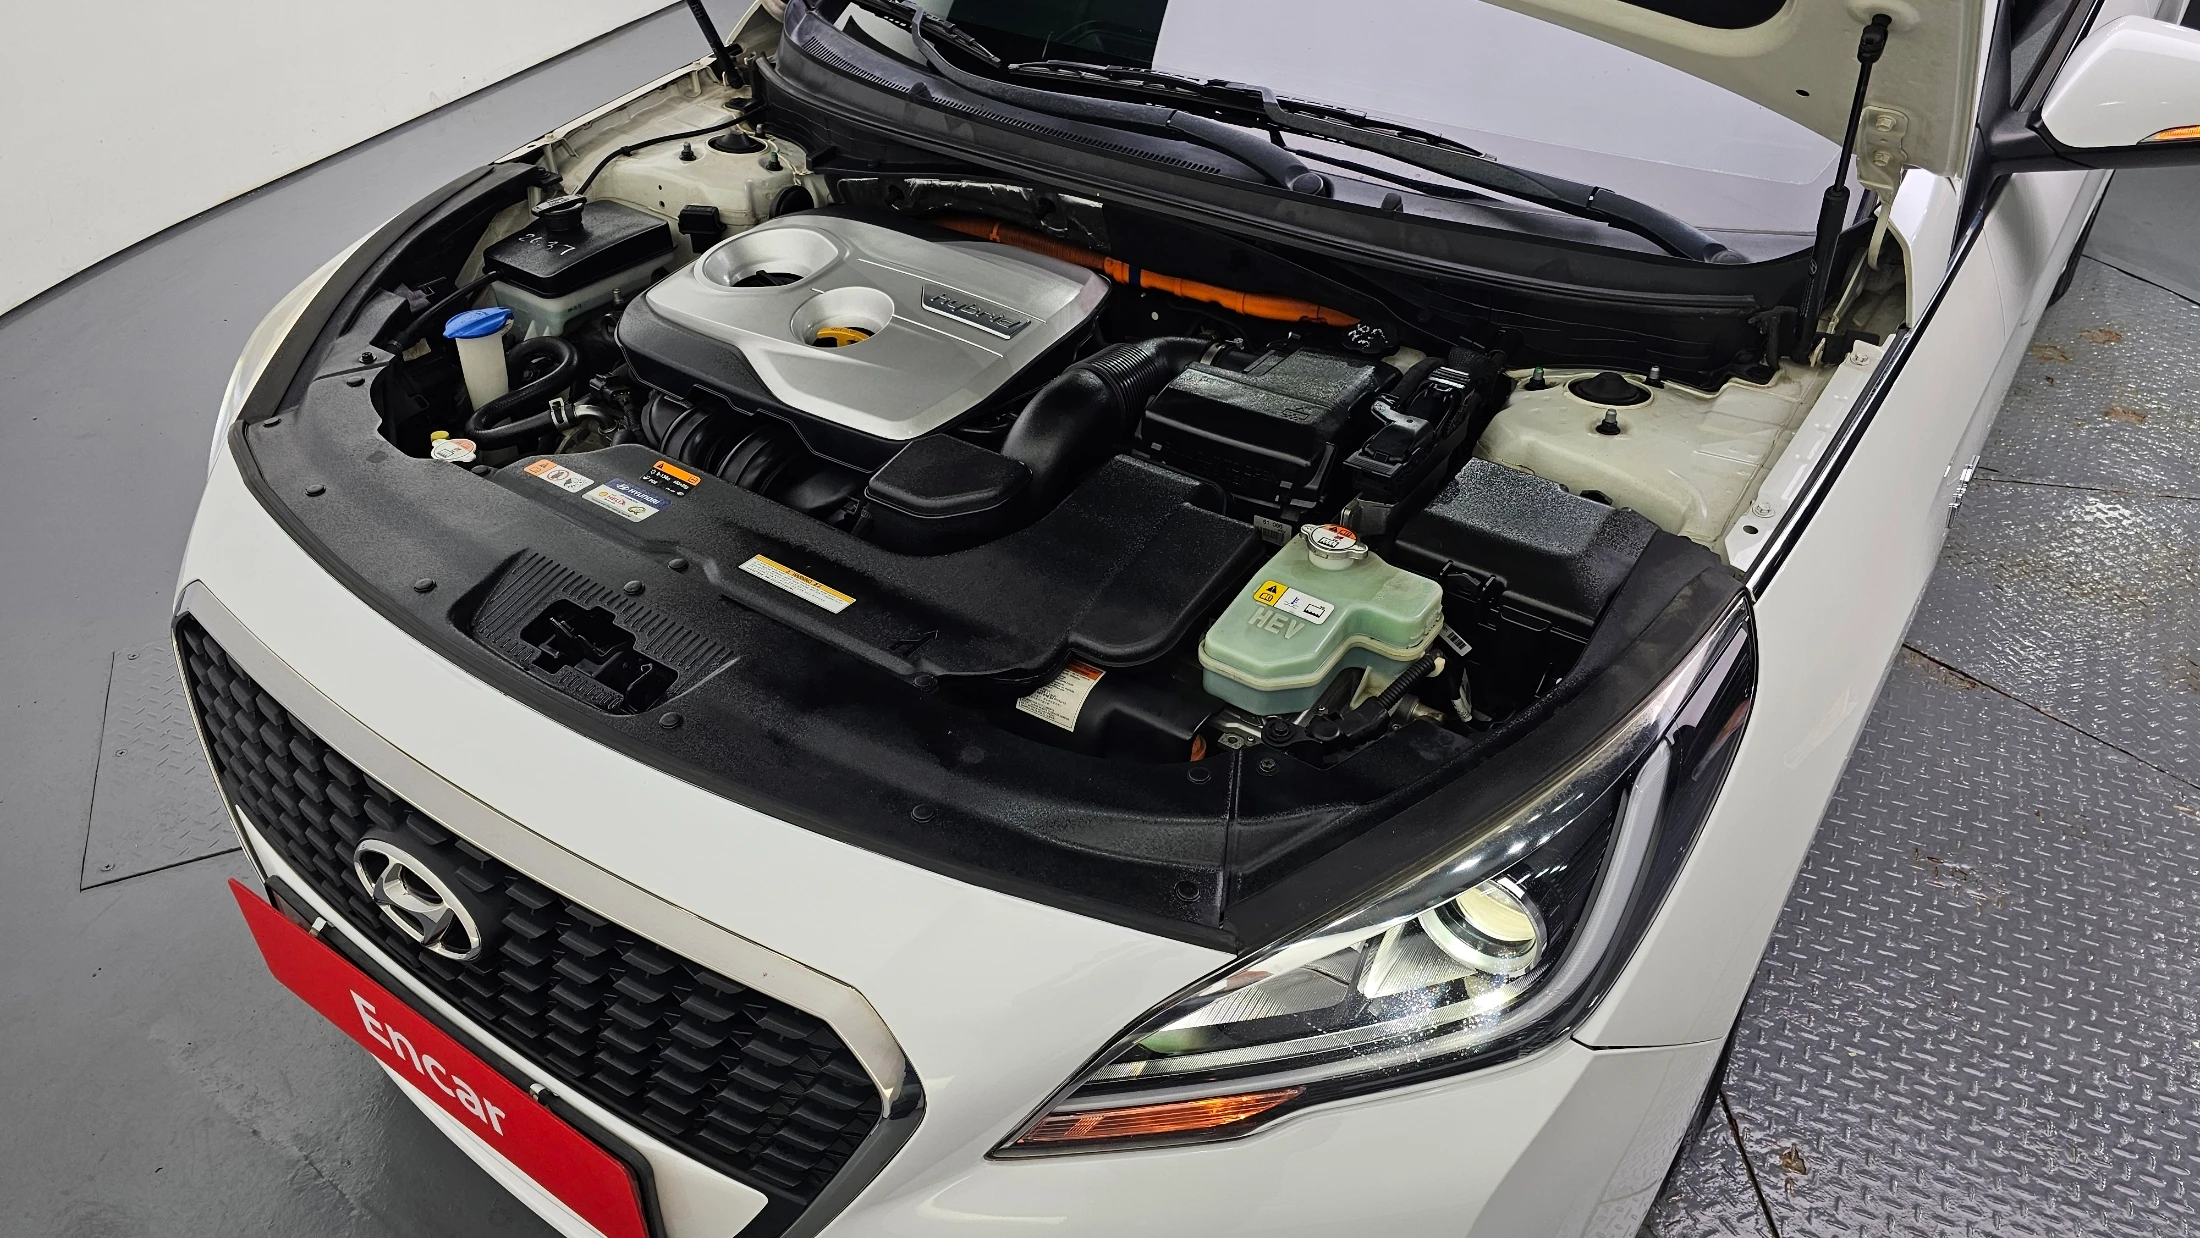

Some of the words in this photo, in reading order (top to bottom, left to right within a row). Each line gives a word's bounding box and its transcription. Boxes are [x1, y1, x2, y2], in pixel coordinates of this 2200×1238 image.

[691, 4, 704, 18] RH
[930, 293, 1021, 329] hybrid
[628, 488, 661, 505] HYUNDAI
[1248, 606, 1306, 640] HEV
[350, 989, 506, 1137] Encar
